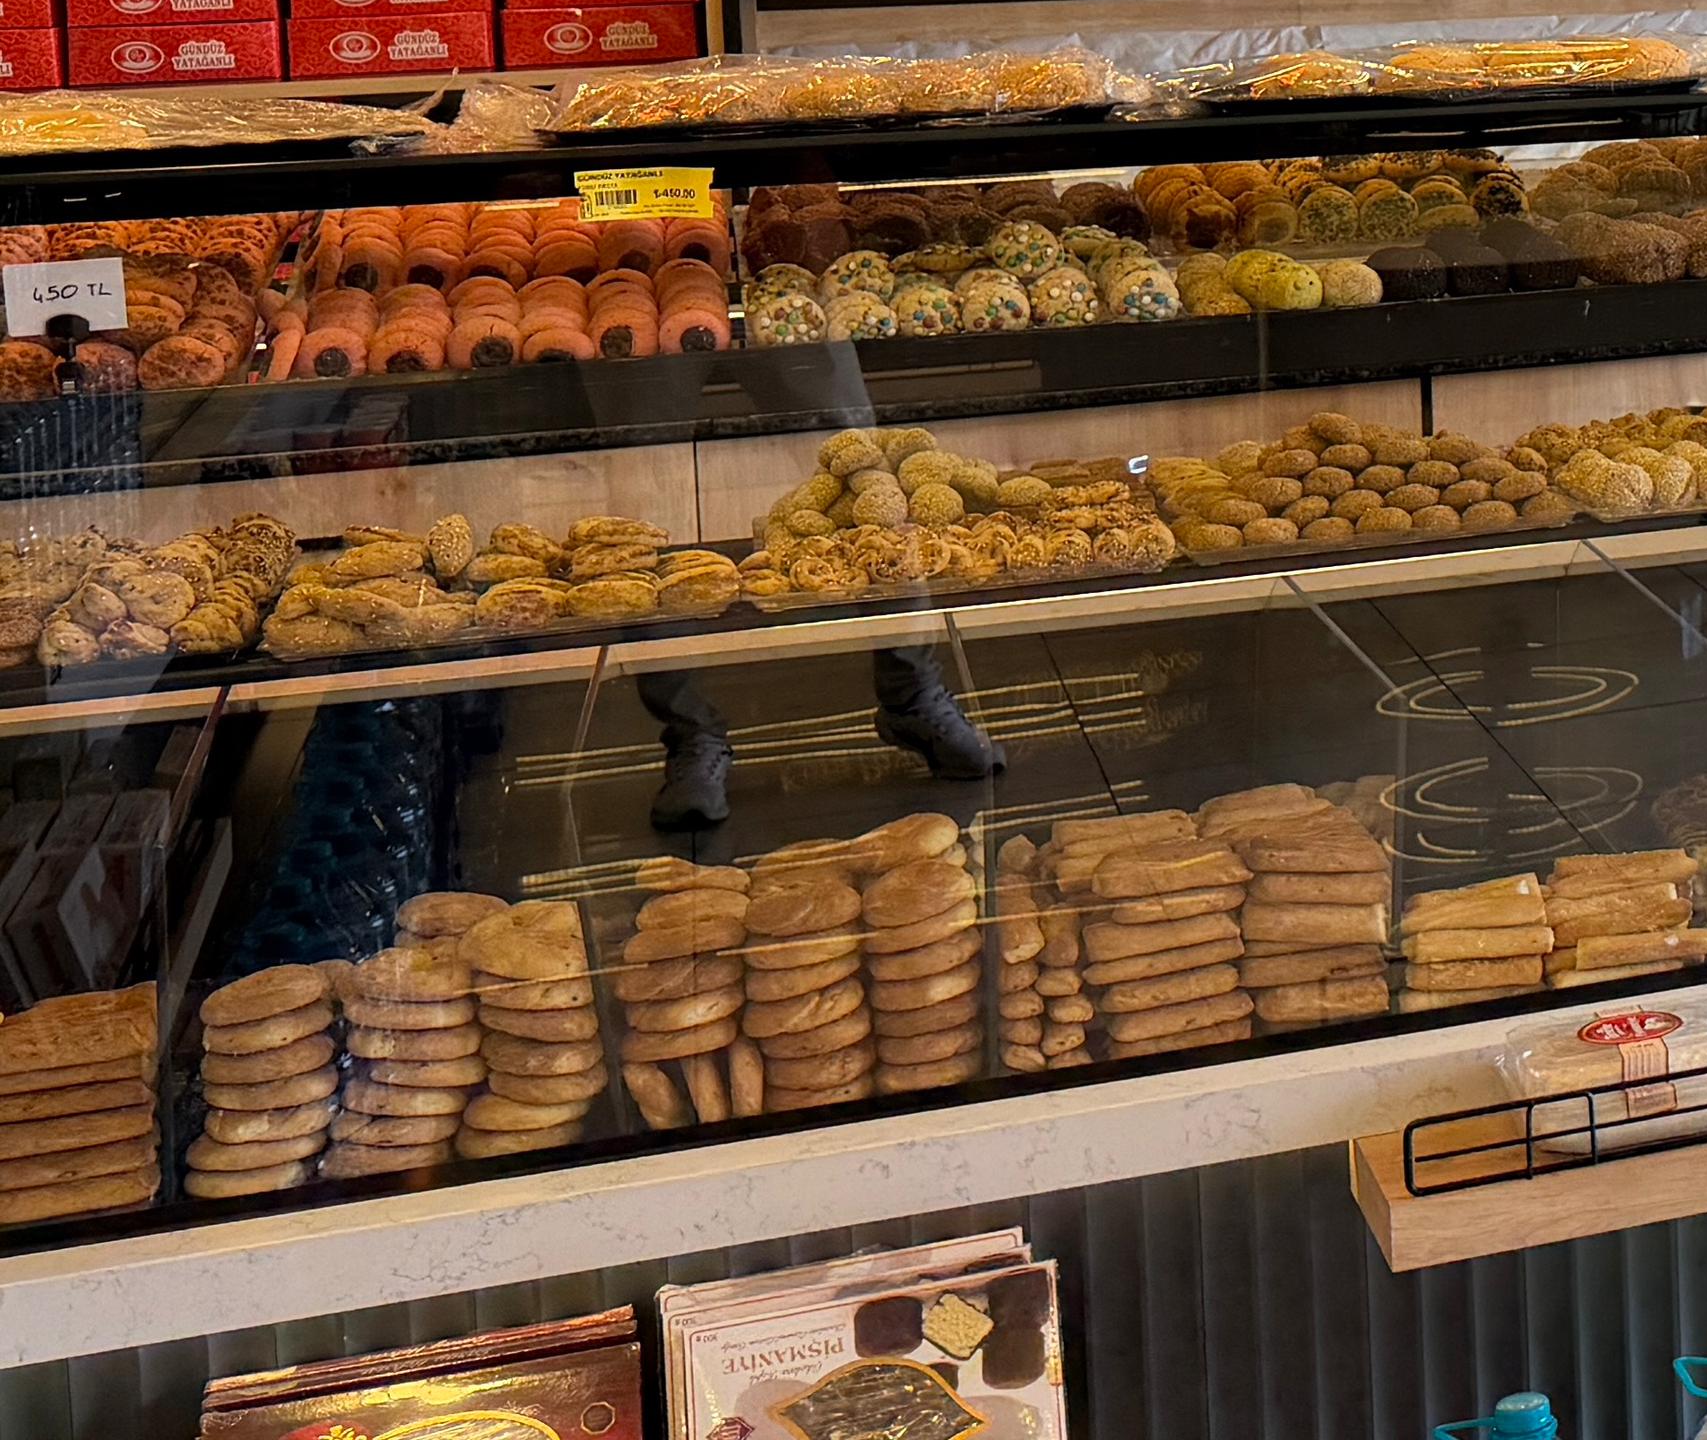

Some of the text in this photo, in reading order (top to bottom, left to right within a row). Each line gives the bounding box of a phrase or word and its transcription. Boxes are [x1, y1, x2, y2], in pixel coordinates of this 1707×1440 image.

[33, 282, 112, 303] 450 TL
[721, 1337, 845, 1375] PİŞMANİYE
